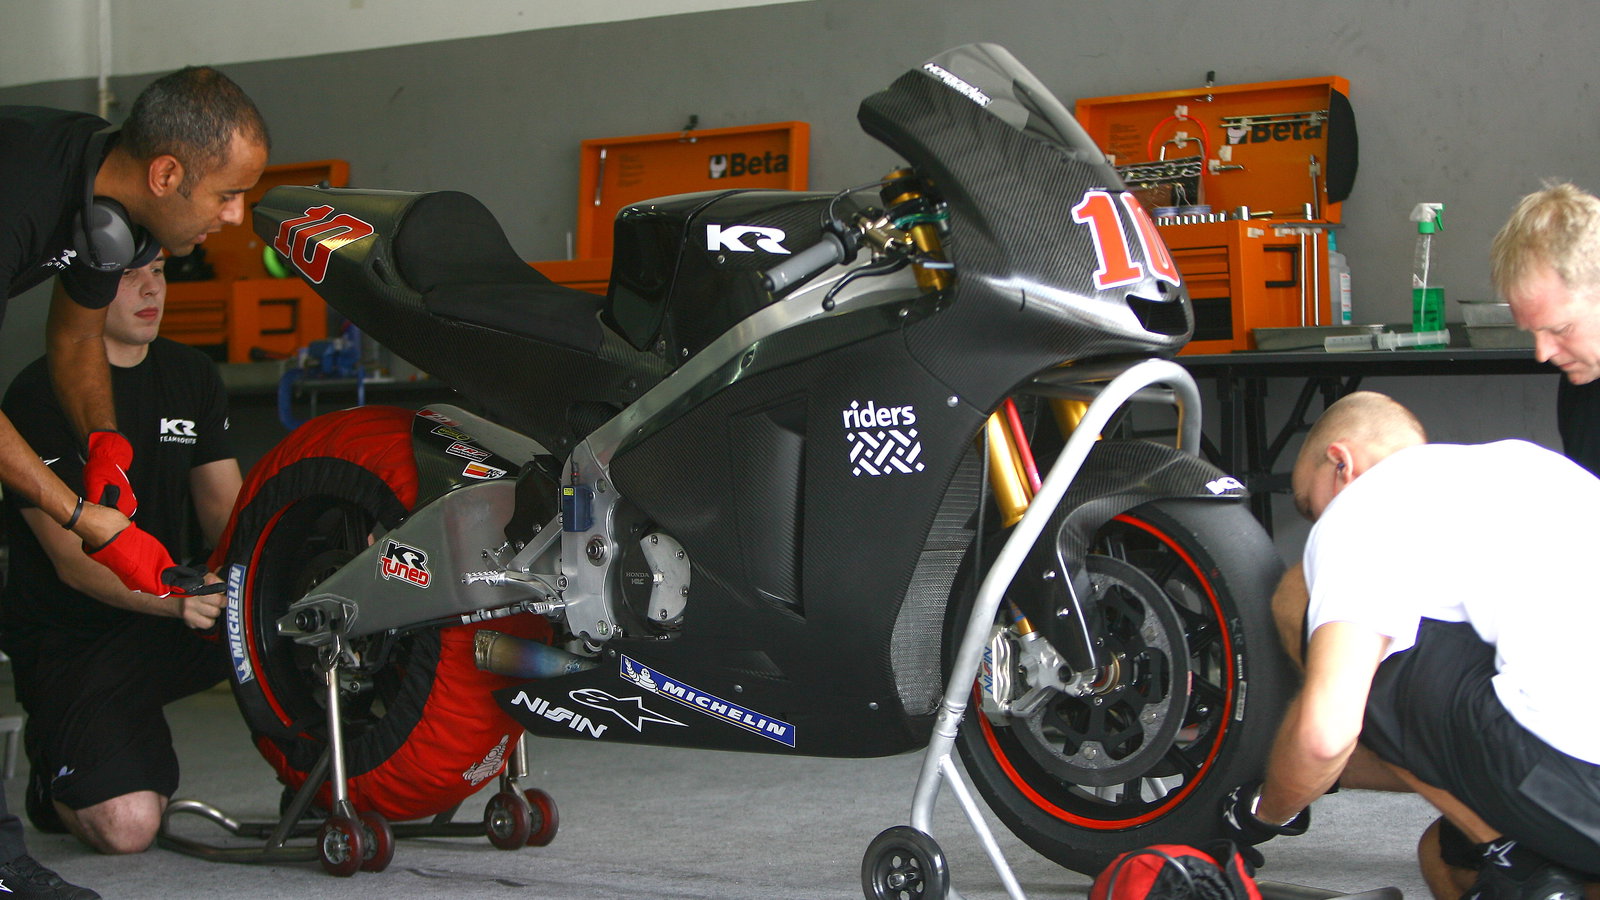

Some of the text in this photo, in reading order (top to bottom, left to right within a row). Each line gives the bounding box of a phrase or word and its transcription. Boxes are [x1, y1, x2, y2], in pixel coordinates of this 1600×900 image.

[1250, 116, 1322, 143] Beta
[731, 152, 789, 176] Beta
[274, 204, 374, 284] 10
[706, 224, 791, 254] KR
[160, 418, 198, 436] KR
[843, 400, 917, 429] riders
[386, 541, 426, 572] KR
[228, 566, 245, 659] MICHELIN
[511, 690, 608, 739] NISSIN
[662, 681, 787, 737] MICHELIN
